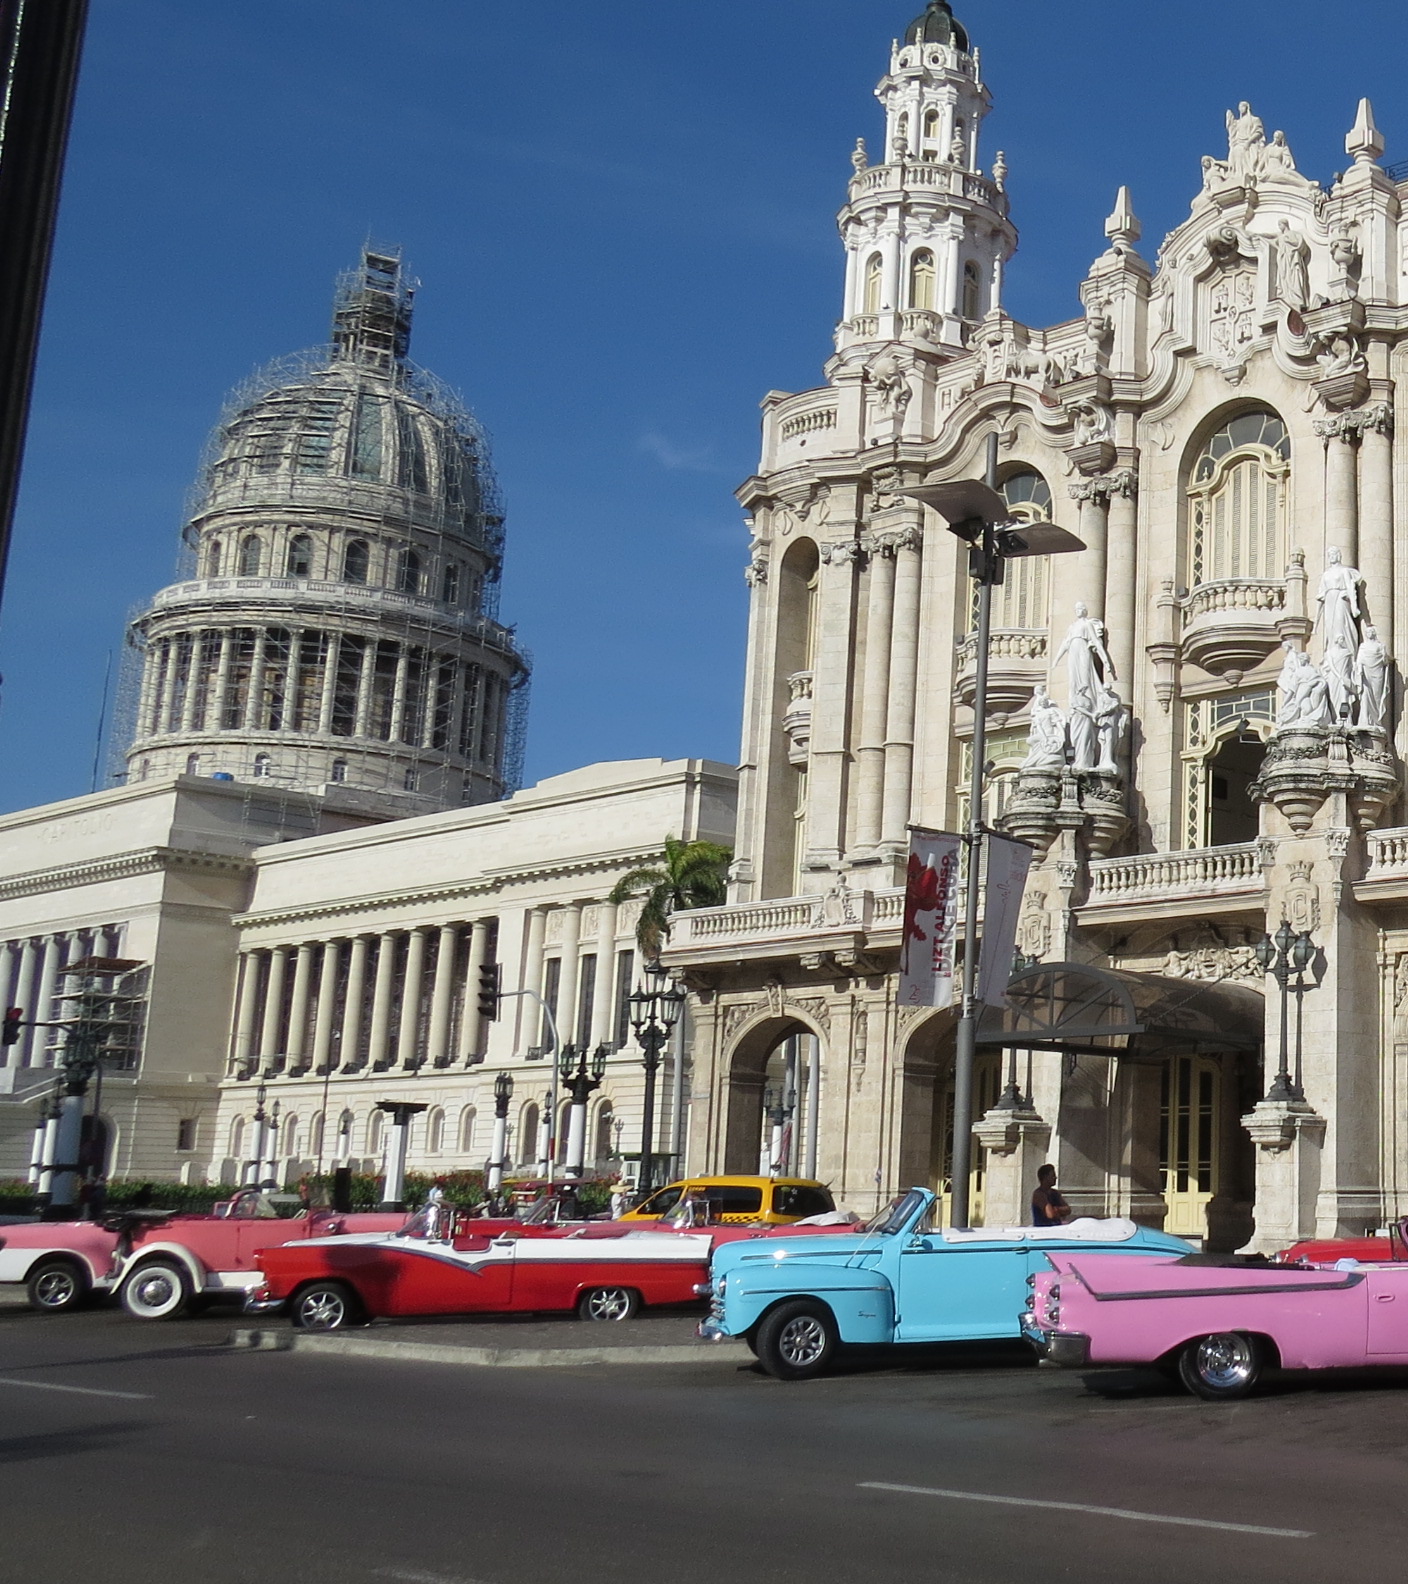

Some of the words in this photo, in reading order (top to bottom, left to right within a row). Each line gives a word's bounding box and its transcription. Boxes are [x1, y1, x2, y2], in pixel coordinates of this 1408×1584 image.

[935, 855, 950, 932] ALFONSO
[945, 848, 959, 901] CUBA
[932, 936, 943, 972] LIZT
[941, 905, 956, 972] DANCE
